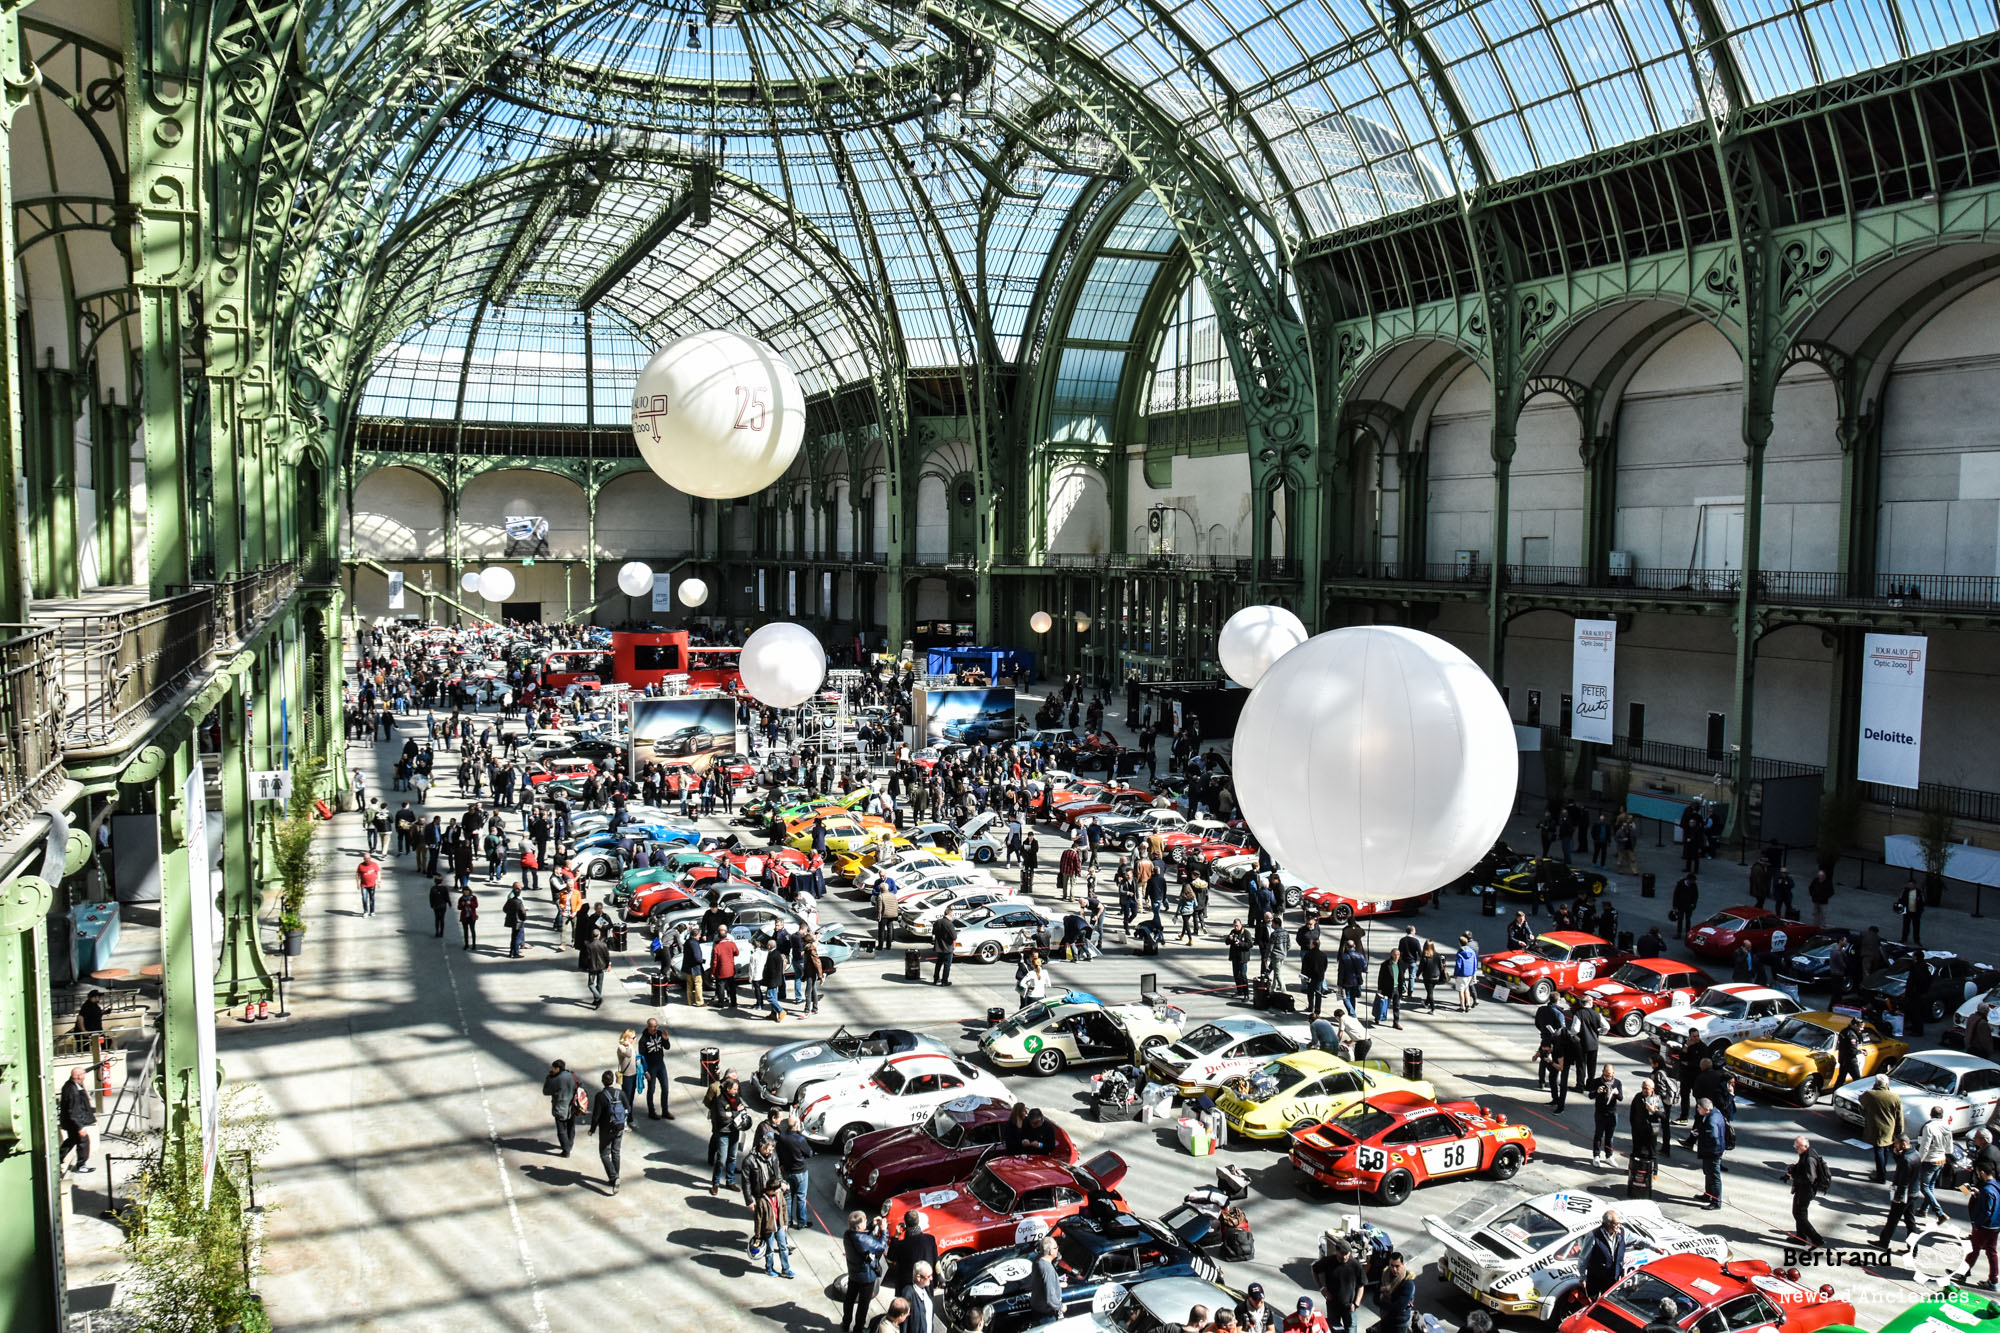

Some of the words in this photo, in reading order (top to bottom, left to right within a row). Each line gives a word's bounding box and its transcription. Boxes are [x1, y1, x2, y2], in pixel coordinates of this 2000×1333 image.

[734, 385, 768, 431] 25
[1875, 646, 1890, 655] TOUR
[1892, 648, 1908, 656] AUTO
[1874, 659, 1890, 668] Optic
[1582, 686, 1605, 697] PETER
[1576, 700, 1610, 715] auto
[1864, 728, 1917, 746] Deloitte.
[911, 1110, 928, 1121] 196
[1971, 1108, 1985, 1118] 222
[1359, 1147, 1384, 1171] 58
[1443, 1144, 1465, 1168] 58
[1566, 1195, 1593, 1214] 430
[1671, 1237, 1720, 1251] CHRISTINE
[1495, 1254, 1555, 1290] CHRISTINE
[1490, 1300, 1499, 1309] BP
